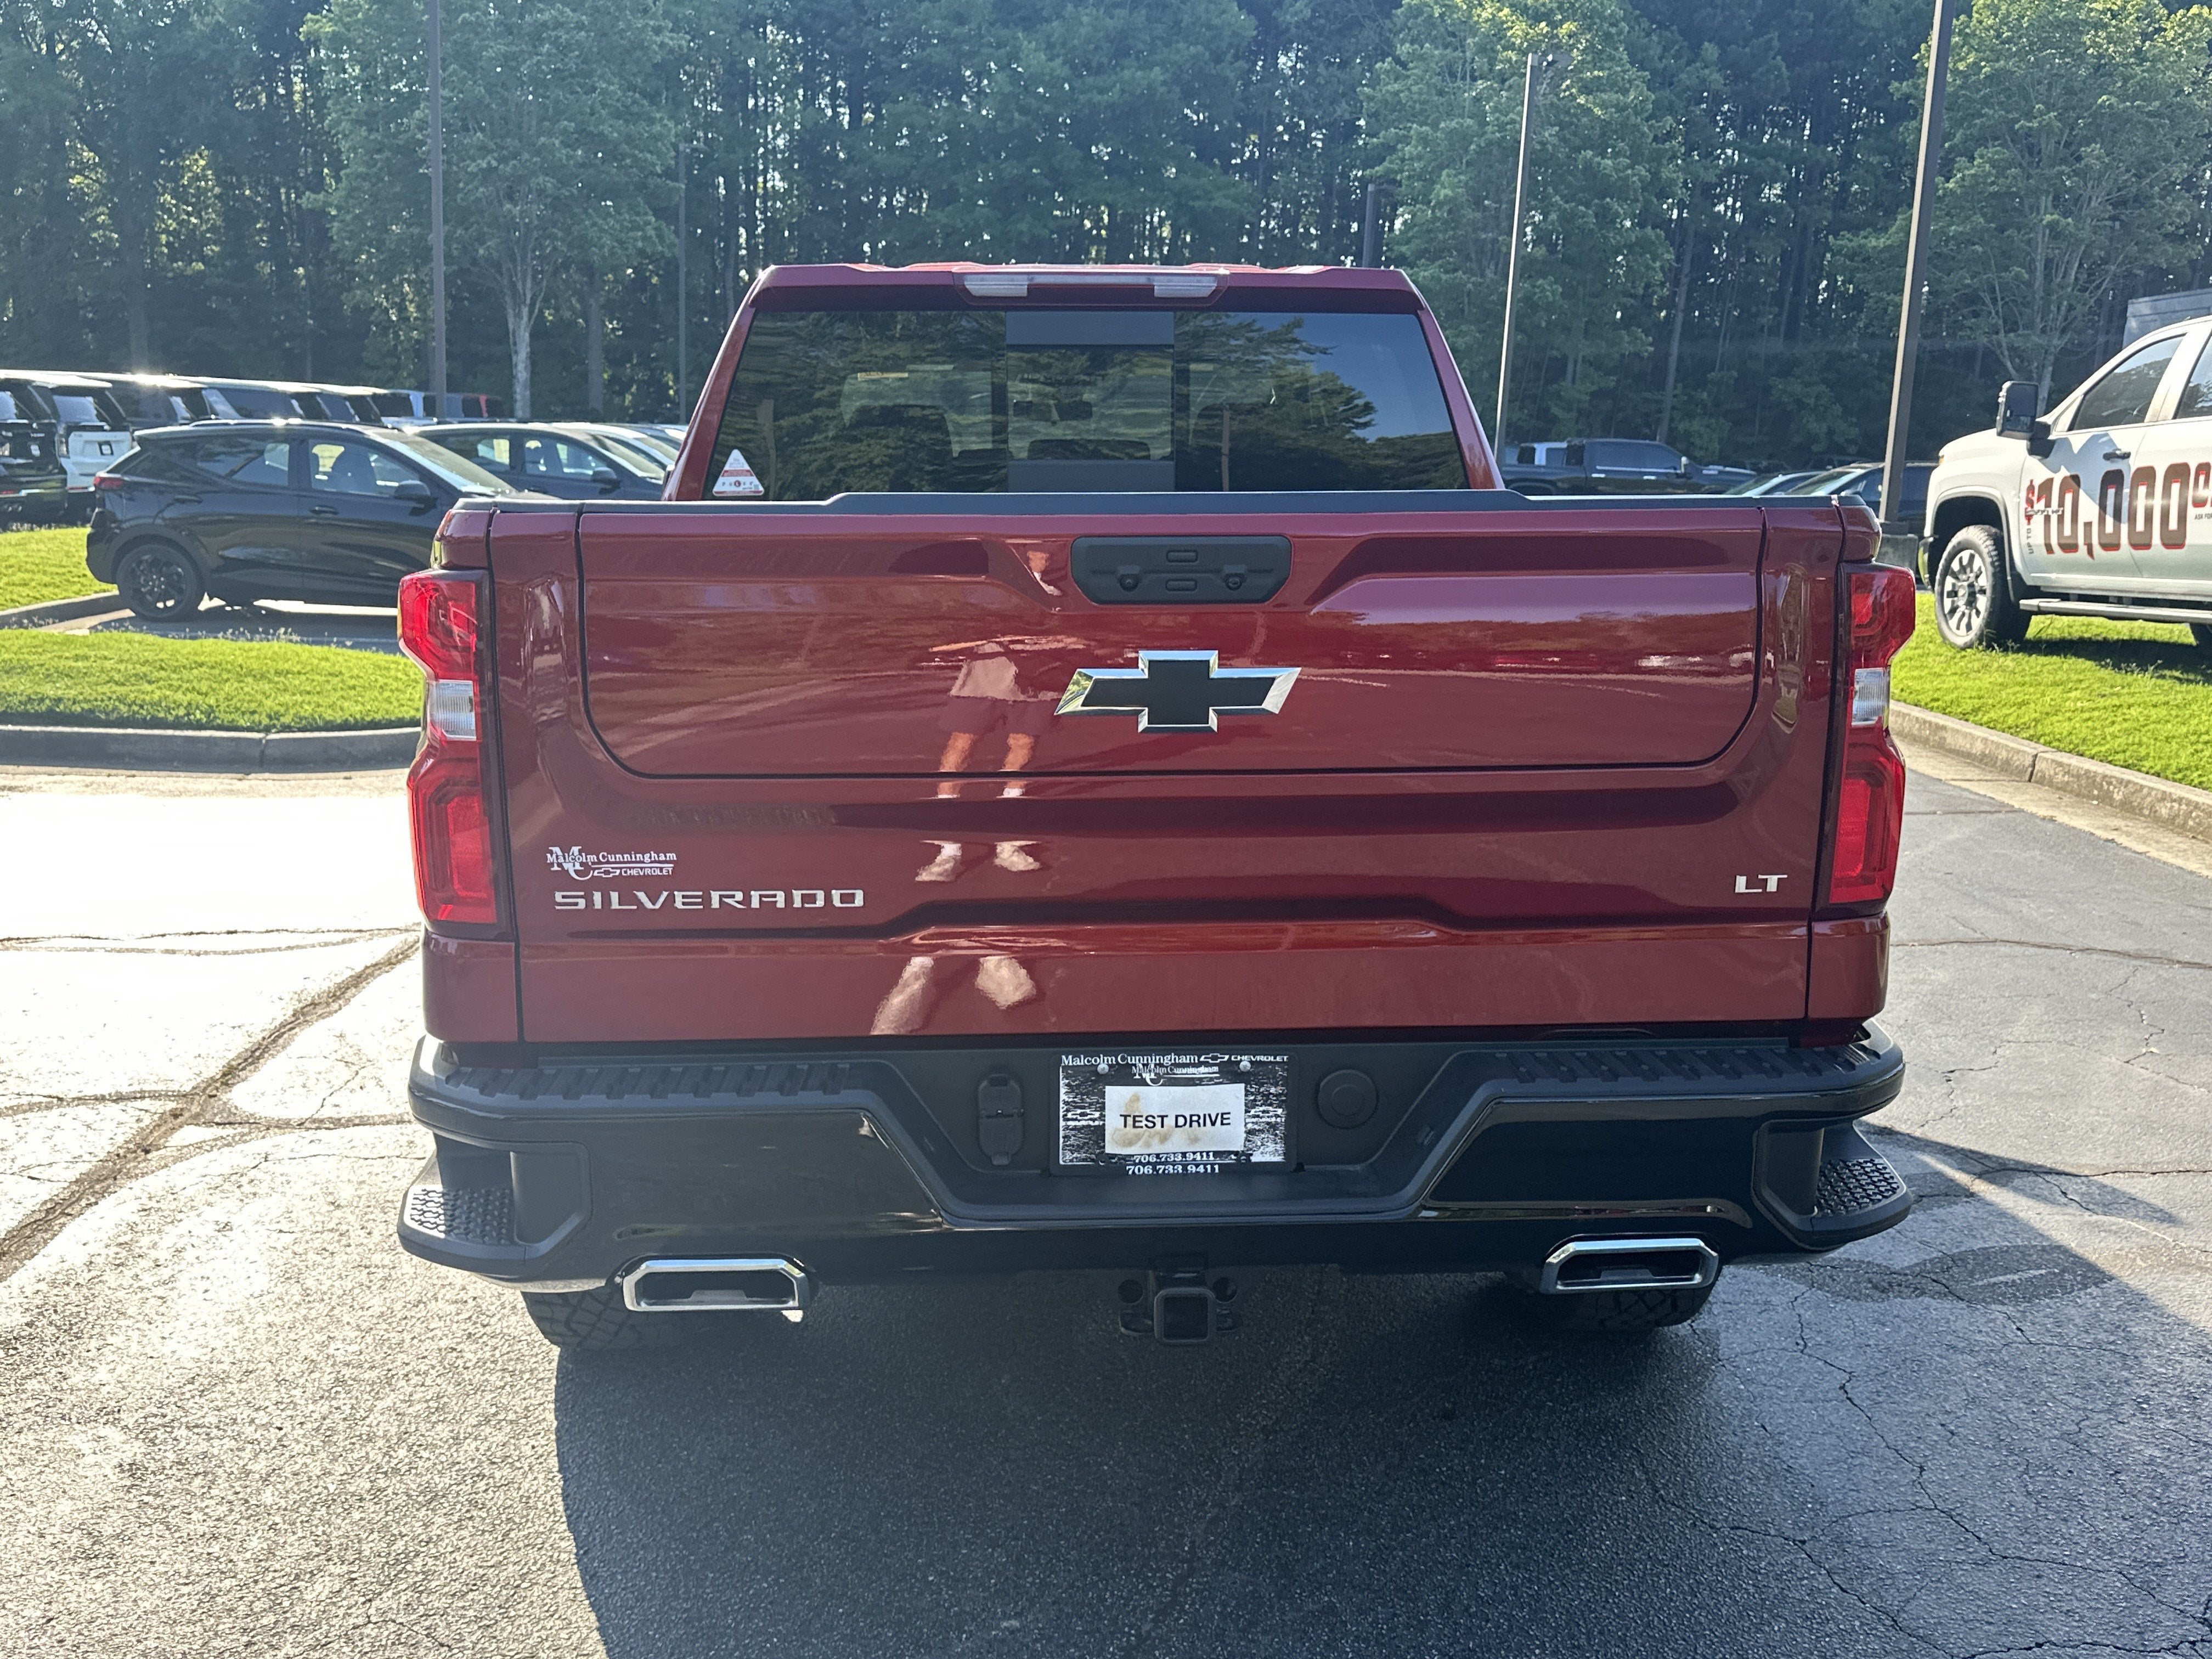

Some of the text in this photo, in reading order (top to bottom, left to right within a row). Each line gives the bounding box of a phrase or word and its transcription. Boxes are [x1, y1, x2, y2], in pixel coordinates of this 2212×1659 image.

[546, 851, 677, 864] Malcolm Cunningham
[621, 867, 673, 876] CHEVROLET
[1735, 874, 1788, 893] LT
[554, 889, 864, 909] SILVERADO
[1061, 1054, 1116, 1065] Malcolm
[1118, 1053, 1198, 1065] Cunningham
[1167, 1065, 1219, 1074] Cunningham
[1120, 1112, 1231, 1128] TEST DRIVE
[1133, 1152, 1214, 1163] 706.733.9411
[1126, 1164, 1220, 1175] 706.733.9411
